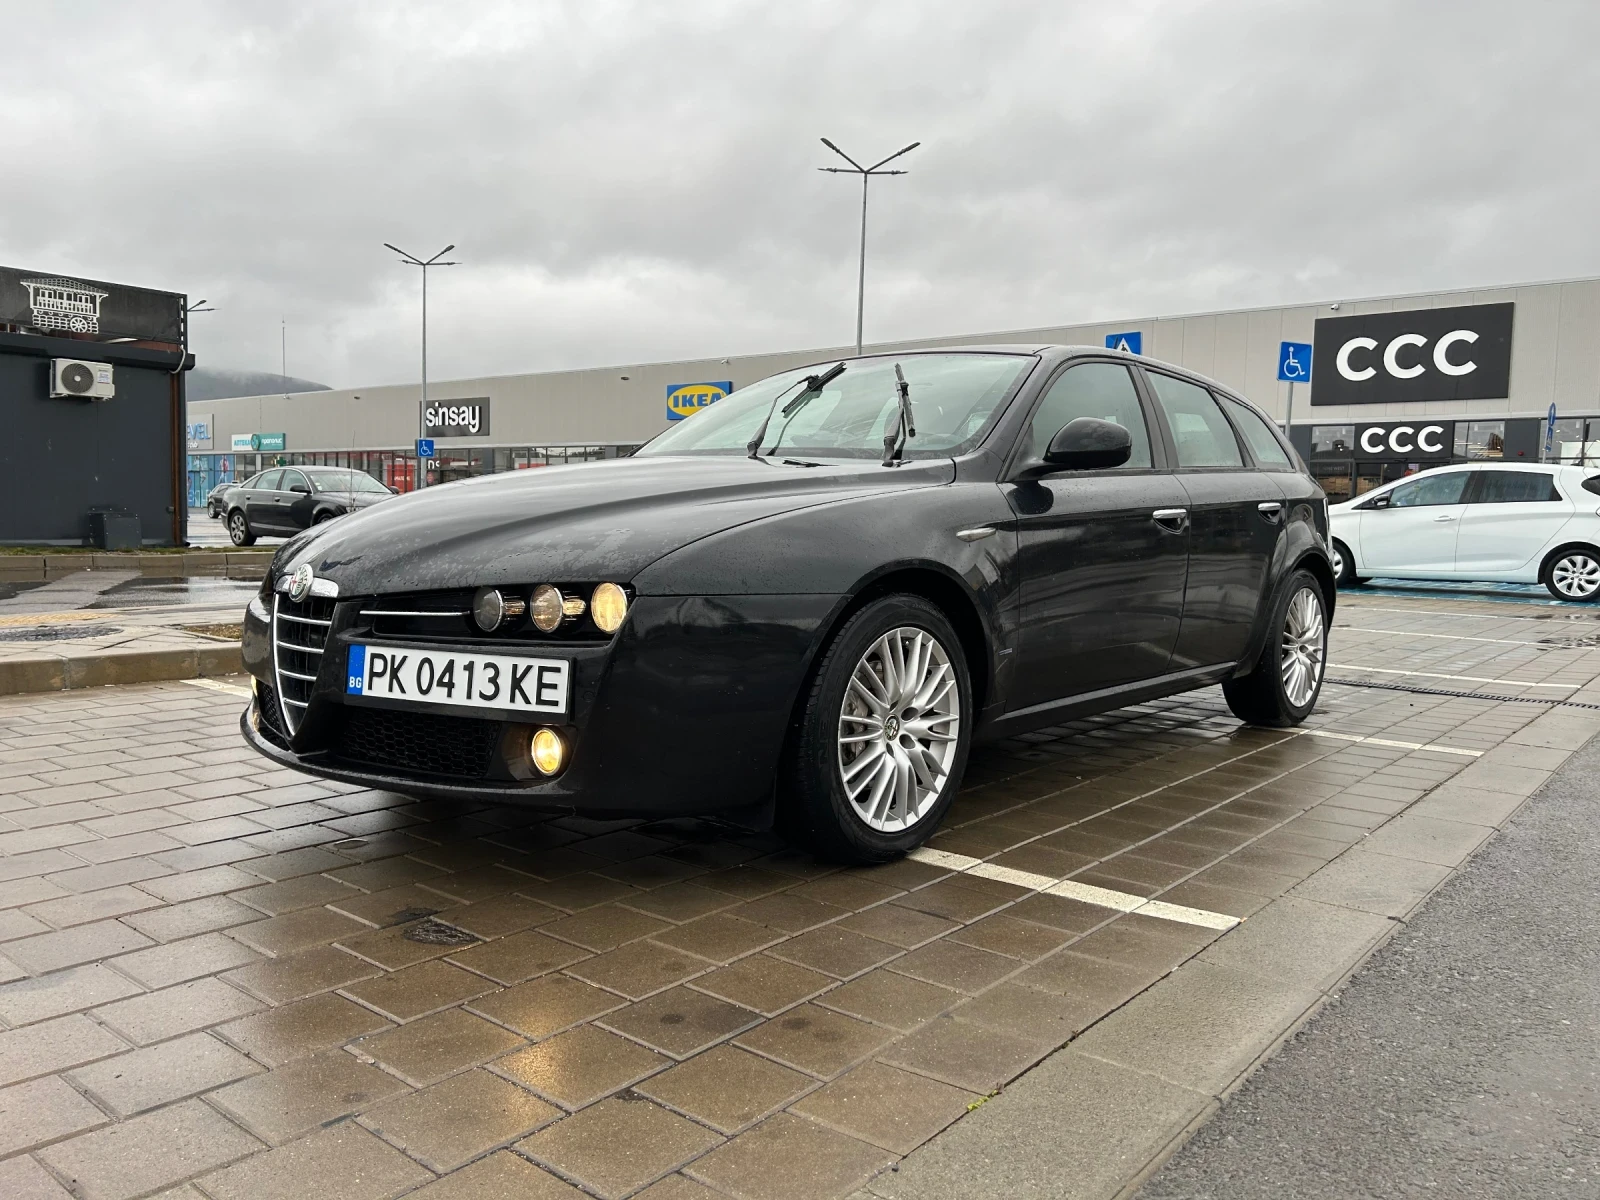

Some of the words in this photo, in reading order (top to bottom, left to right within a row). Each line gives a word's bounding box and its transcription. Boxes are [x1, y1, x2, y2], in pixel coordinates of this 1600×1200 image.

[1336, 329, 1480, 381] CCC
[673, 392, 722, 408] IKEA
[425, 401, 480, 433] sinsay
[1360, 425, 1444, 454] CCC
[349, 676, 362, 688] BG
[367, 652, 408, 694] PK
[416, 656, 500, 701] 0413
[509, 663, 562, 707] KE
